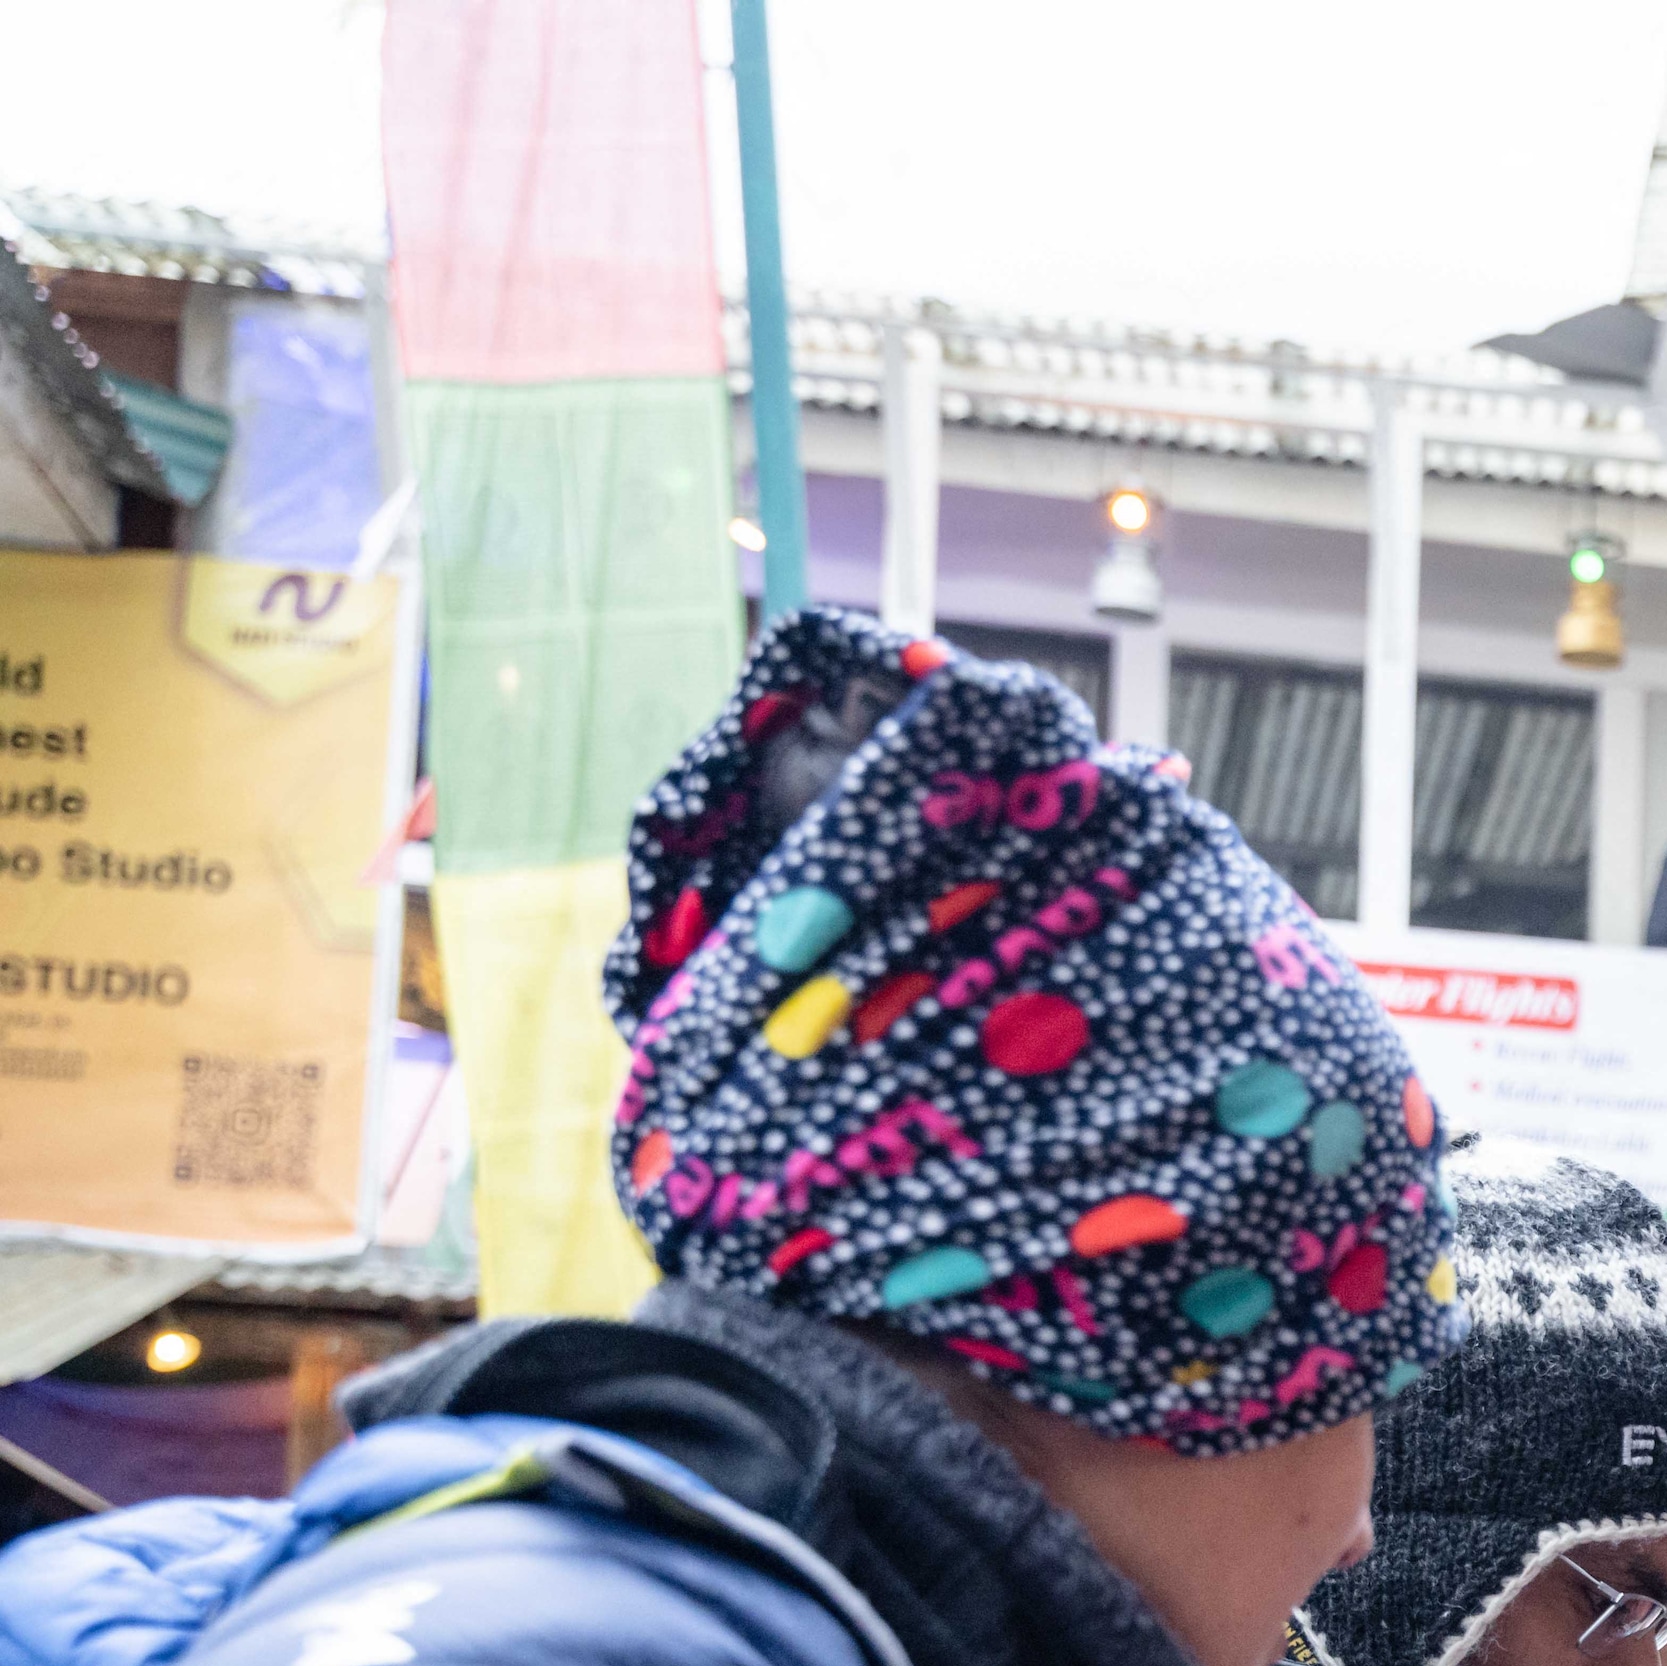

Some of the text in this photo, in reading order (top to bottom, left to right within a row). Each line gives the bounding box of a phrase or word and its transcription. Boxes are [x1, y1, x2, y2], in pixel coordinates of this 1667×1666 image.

[0, 722, 86, 757] est
[61, 842, 231, 893] Studio
[0, 955, 190, 1008] STUDIO
[1437, 971, 1574, 1025] Flights
